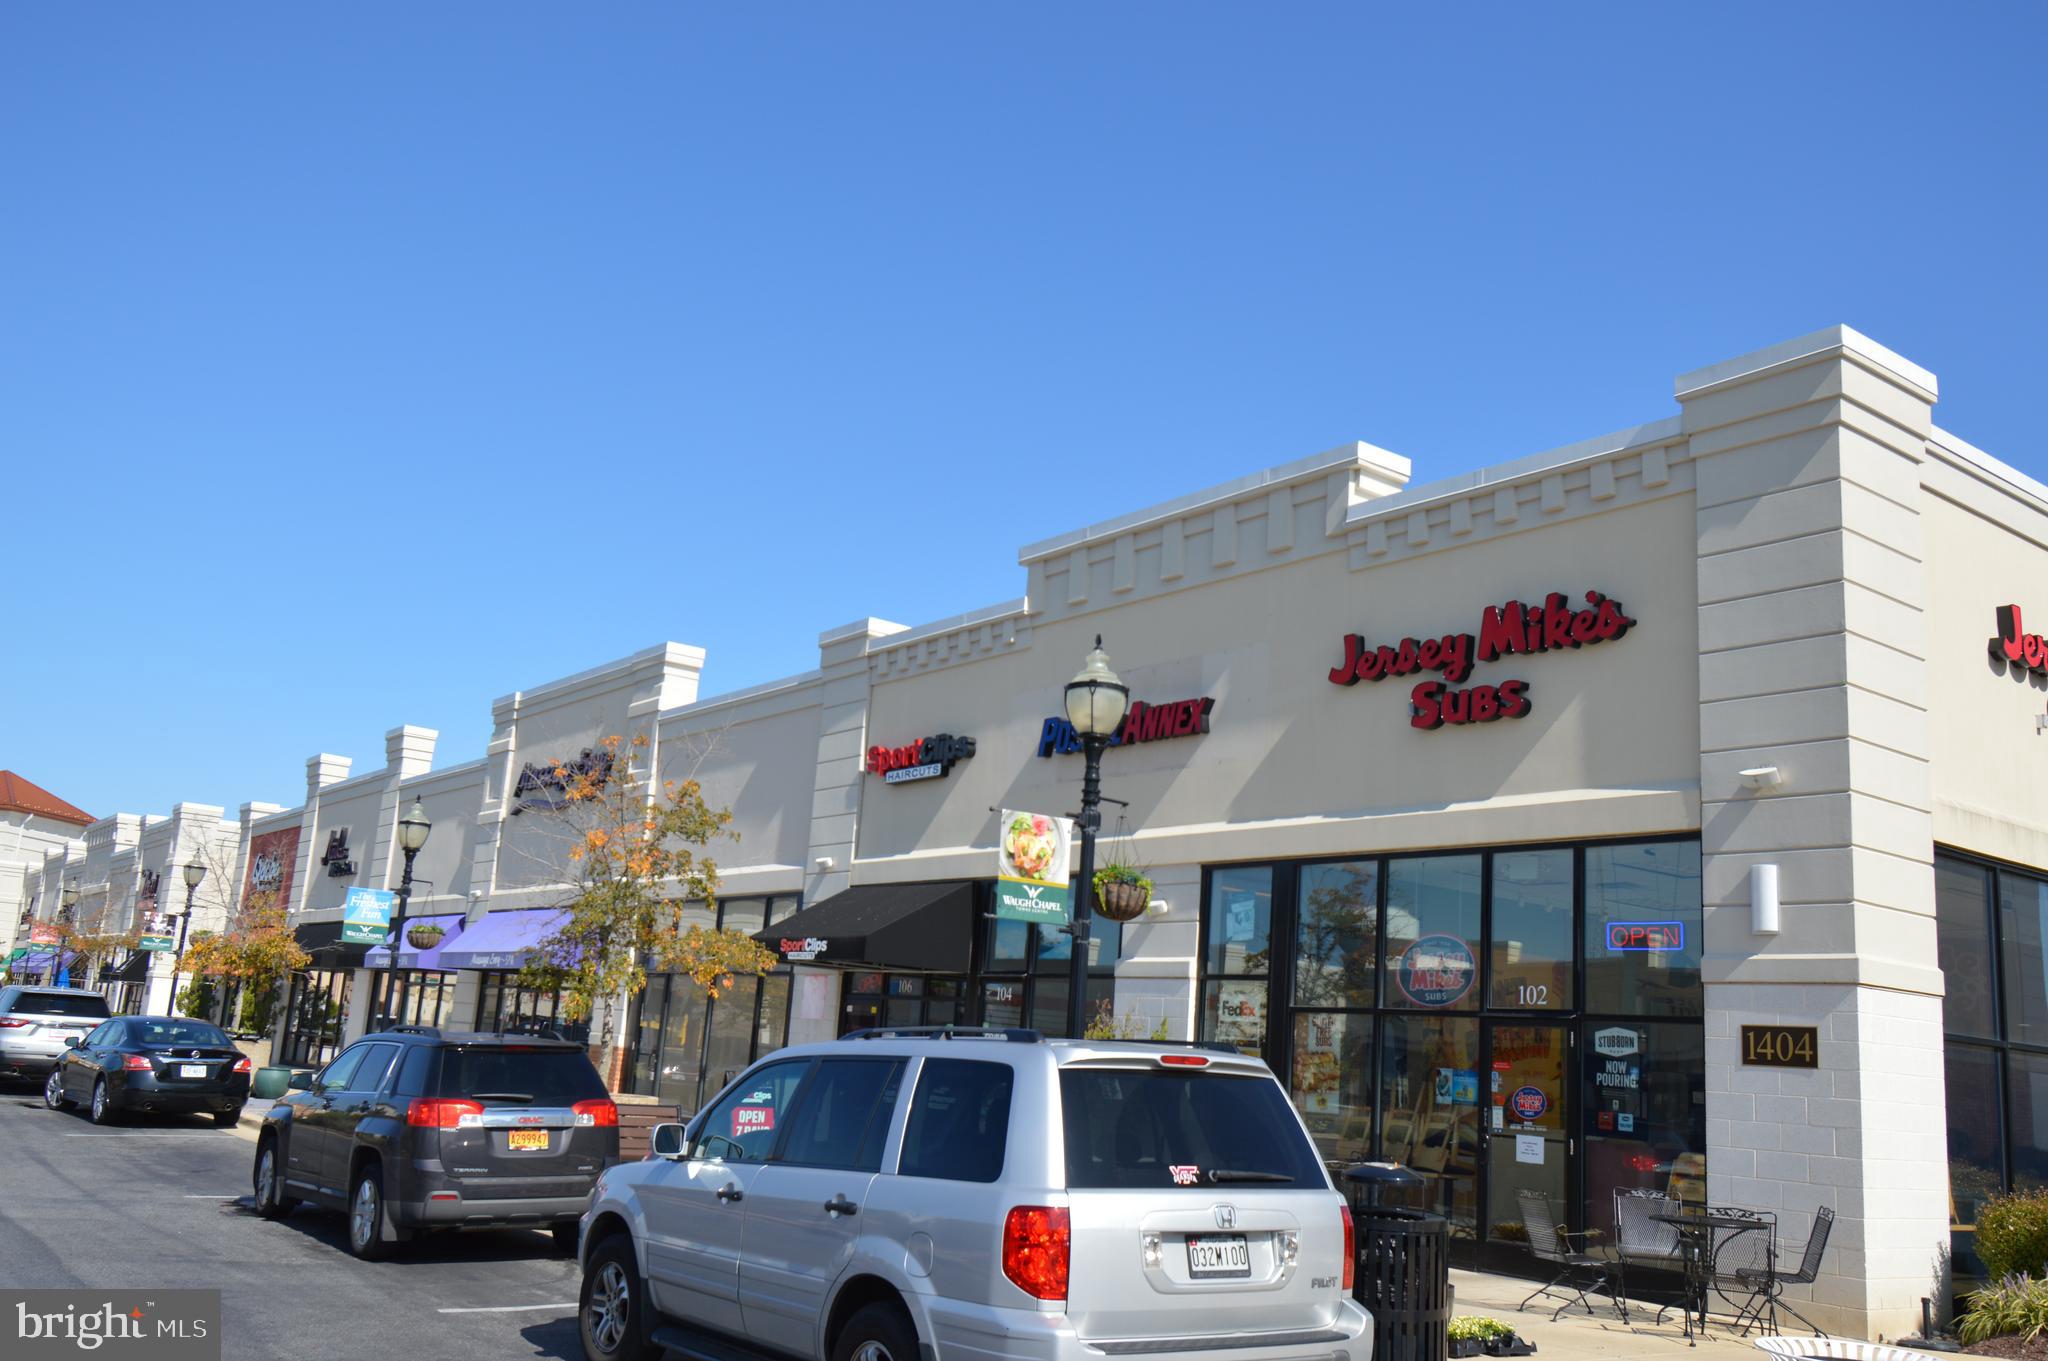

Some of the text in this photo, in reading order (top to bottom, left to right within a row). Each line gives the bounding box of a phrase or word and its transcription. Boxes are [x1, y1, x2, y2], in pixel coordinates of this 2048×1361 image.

[1328, 590, 1637, 684] Jersey Mike's
[1410, 680, 1531, 730] SUBS
[1121, 697, 1215, 744] ANNEX
[887, 764, 939, 781] HAIRCUTS
[1003, 895, 1062, 911] WAUGH CHAPEL
[1611, 927, 1679, 947] OPEN
[898, 979, 912, 993] 106
[997, 987, 1012, 1000] 104
[1425, 992, 1447, 1000] SUBS
[1518, 985, 1548, 1005] 102
[1222, 1001, 1256, 1016] FedEx
[1598, 1036, 1634, 1049] STUBBORN
[1746, 1031, 1813, 1062] 1404
[1606, 1060, 1627, 1073] NOW
[738, 1110, 765, 1123] OPEN
[1311, 1276, 1338, 1289] PILOT
